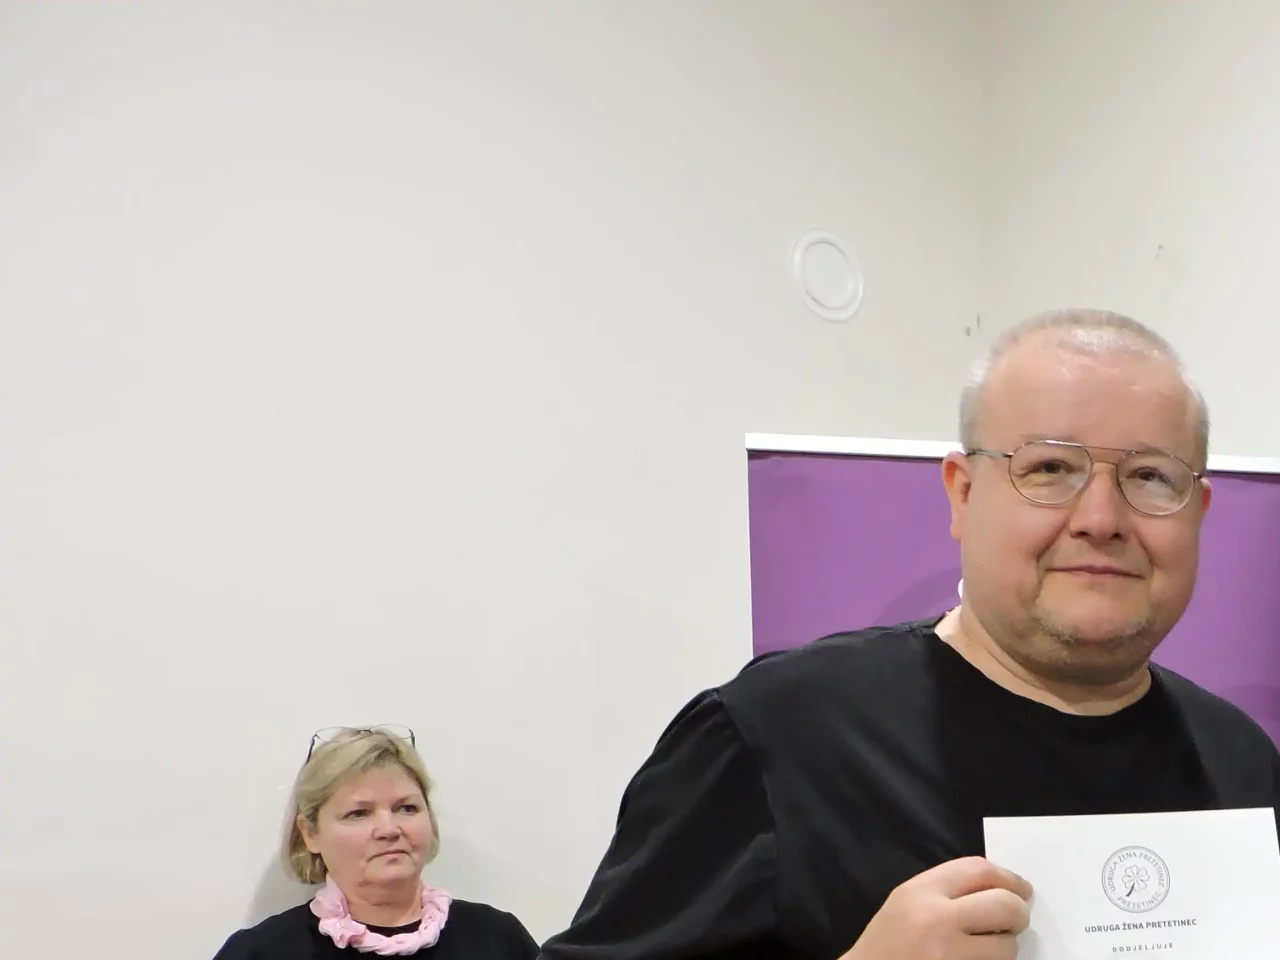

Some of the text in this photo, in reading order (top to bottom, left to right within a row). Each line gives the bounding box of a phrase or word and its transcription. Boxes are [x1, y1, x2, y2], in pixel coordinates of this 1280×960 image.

[1084, 918, 1198, 933] UDRUGA ŽENA PRETETINEC
[1112, 942, 1173, 953] DODJELJUJE
